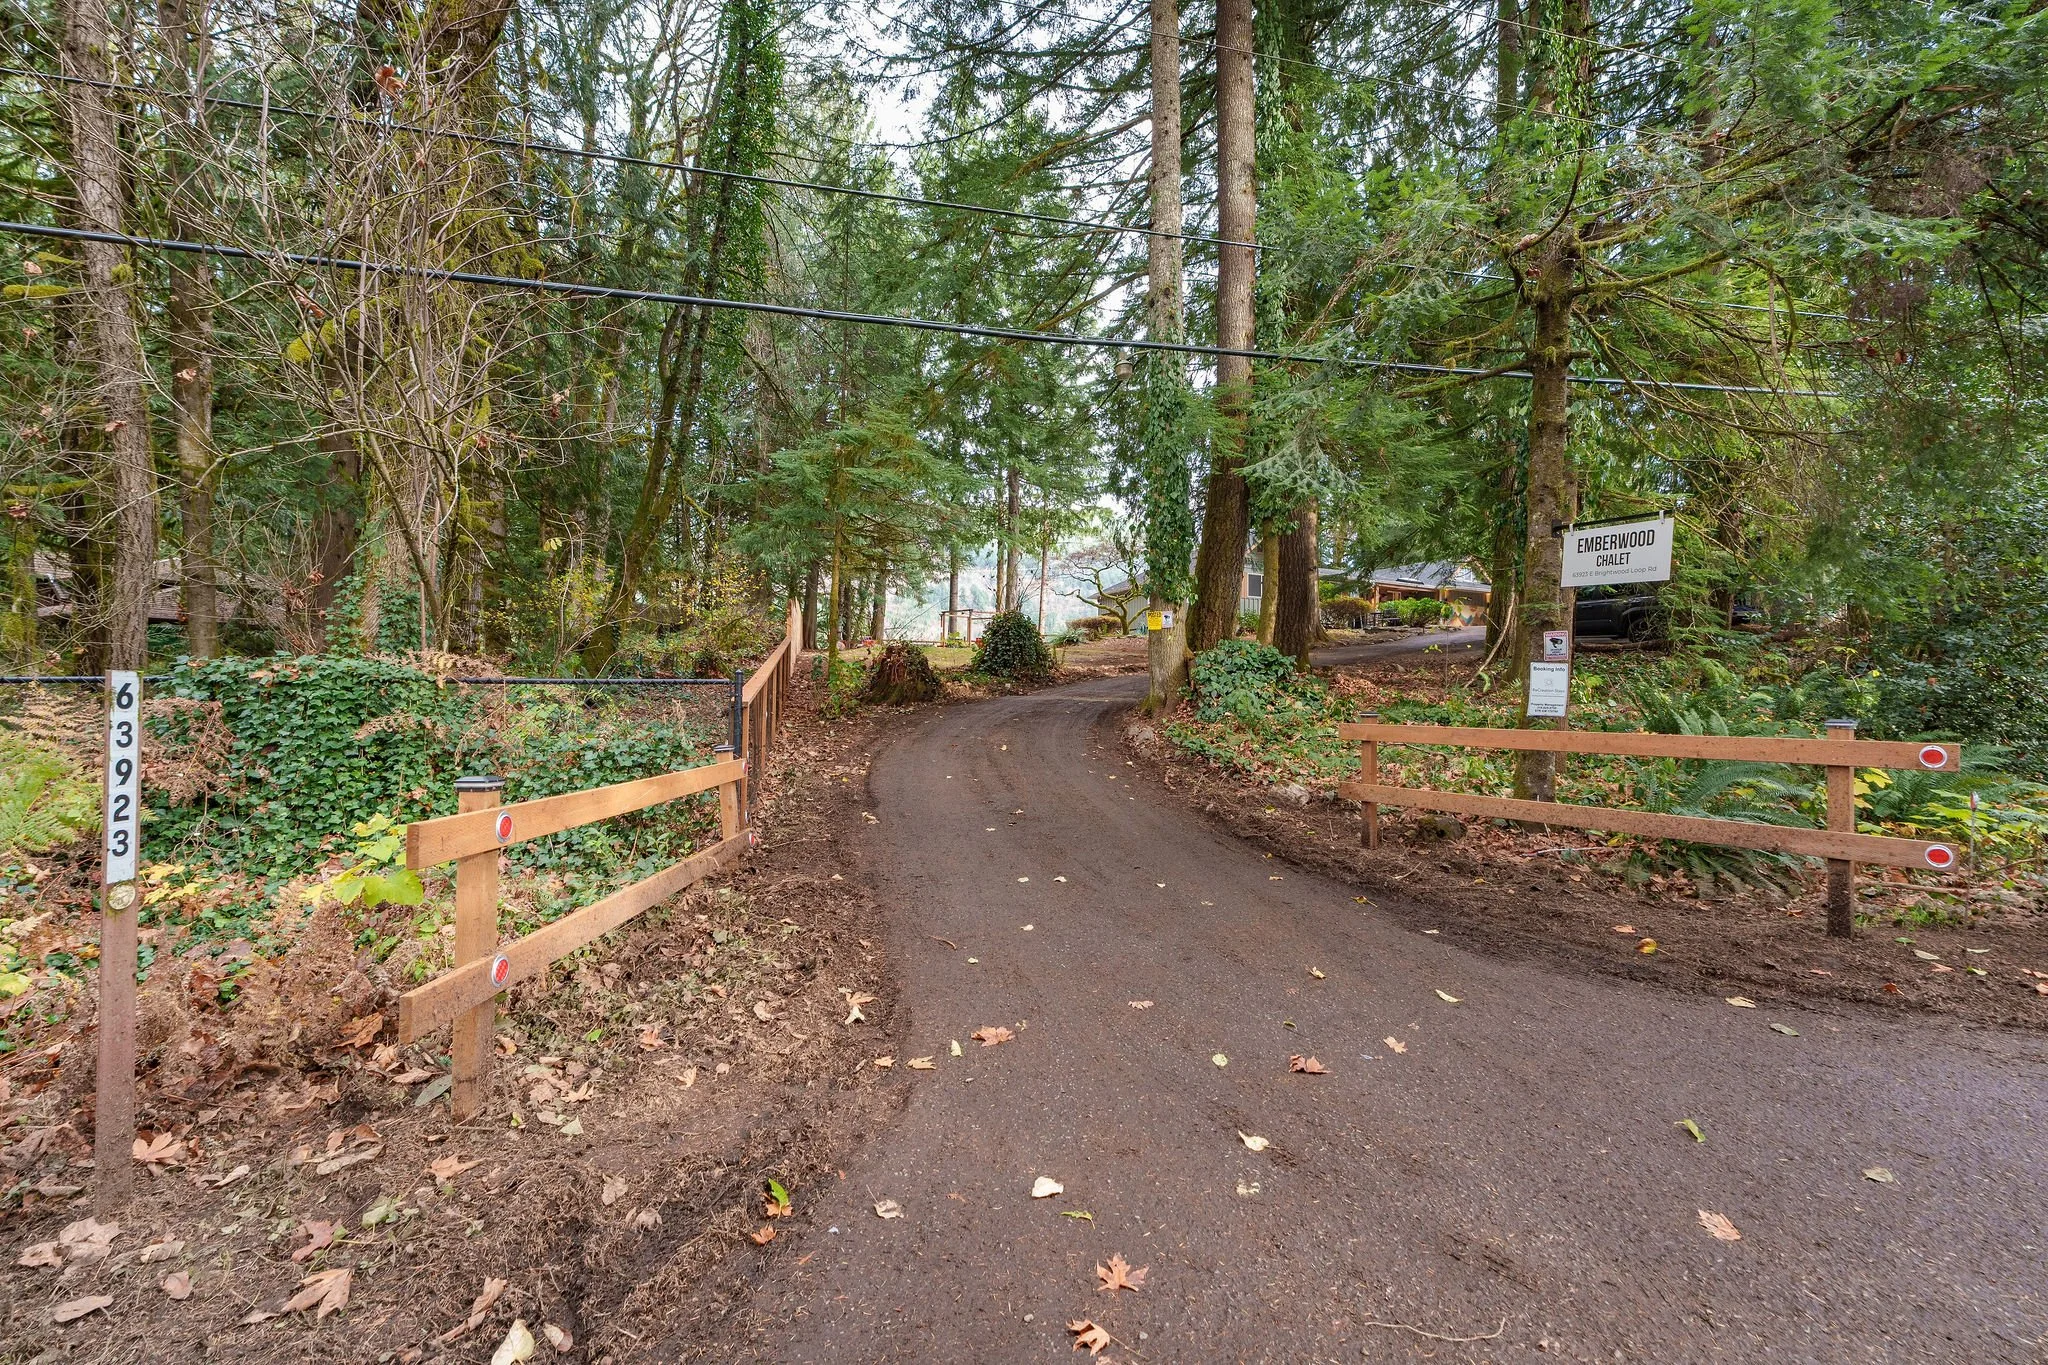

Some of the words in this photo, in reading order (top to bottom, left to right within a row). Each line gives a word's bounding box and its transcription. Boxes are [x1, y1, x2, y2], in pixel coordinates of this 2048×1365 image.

[1577, 529, 1655, 554] EMBERWOOD
[1596, 552, 1631, 567] CHALET
[1595, 568, 1629, 577] Brightwood
[1631, 566, 1647, 574] Loop
[111, 682, 134, 857] 63923
